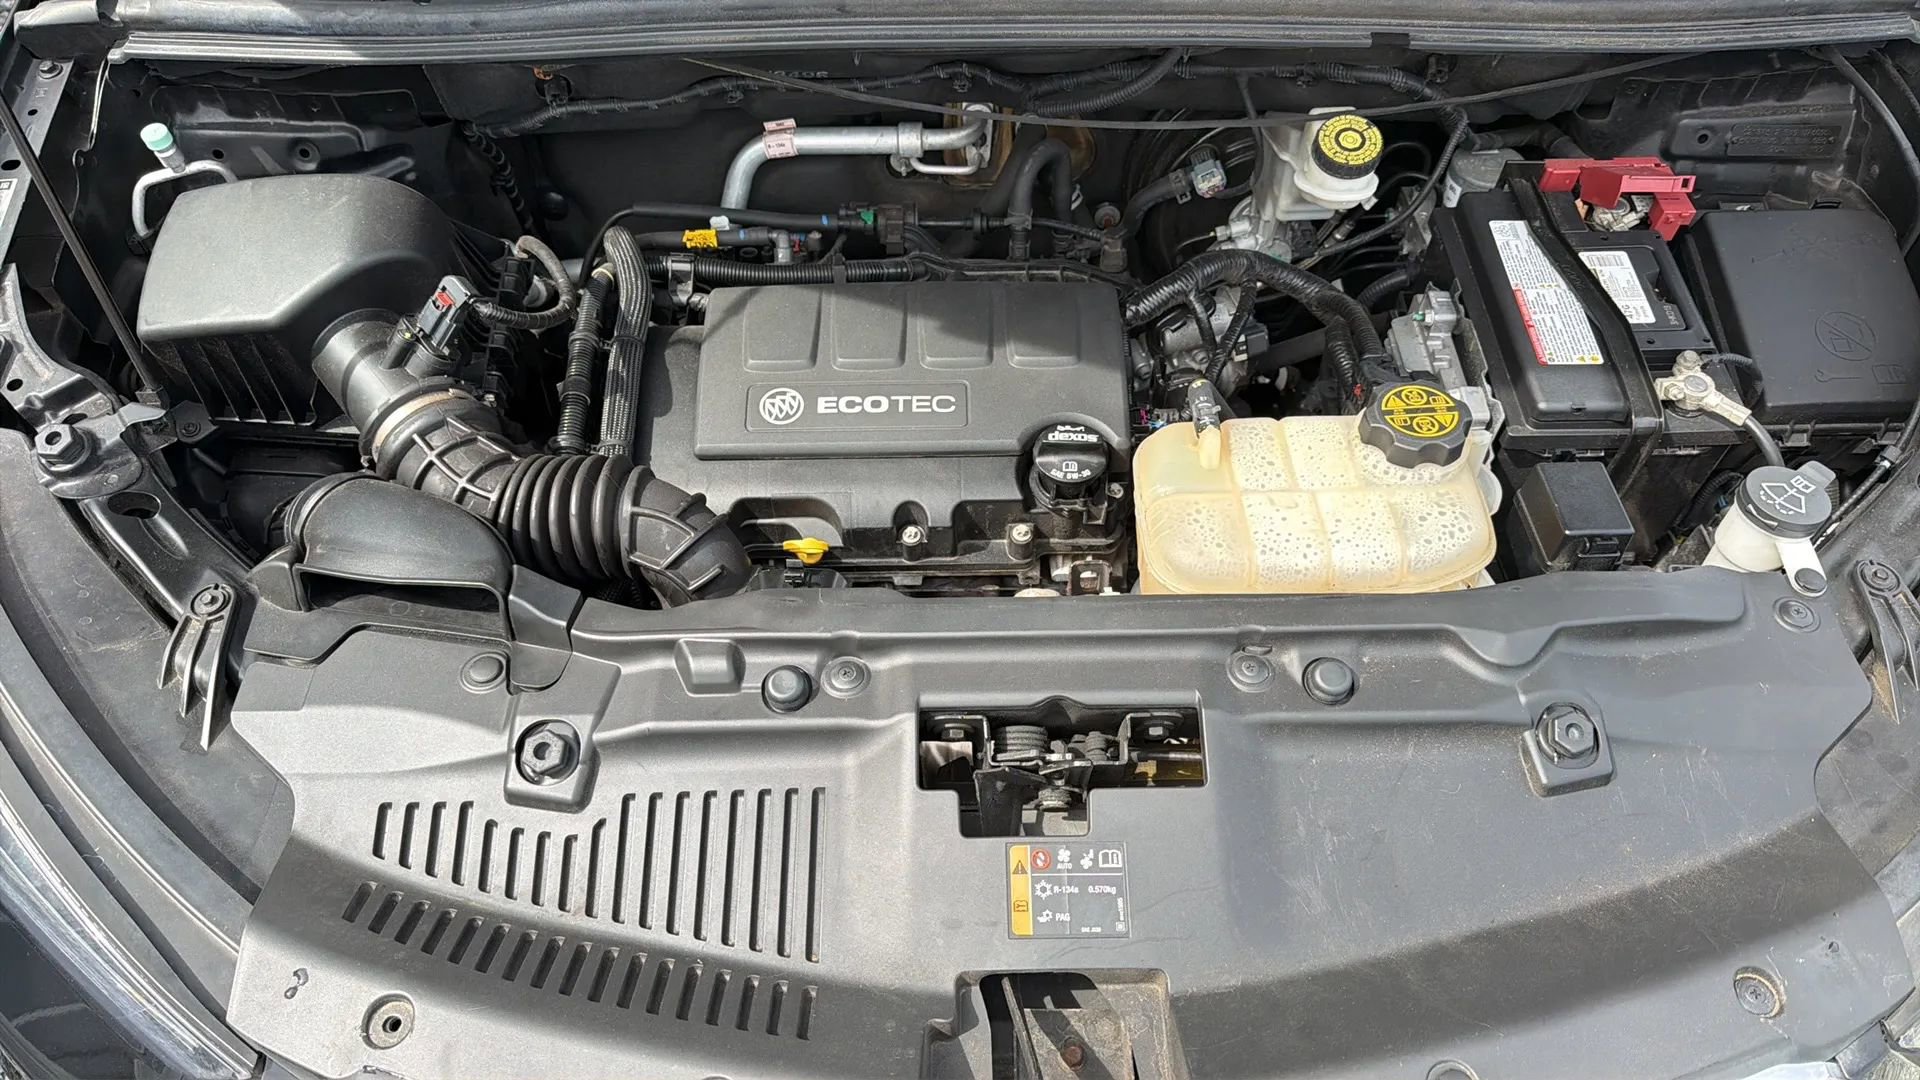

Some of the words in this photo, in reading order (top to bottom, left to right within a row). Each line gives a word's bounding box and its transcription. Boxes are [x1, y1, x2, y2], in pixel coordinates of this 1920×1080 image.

[817, 395, 956, 413] ECOTEC
[1047, 430, 1099, 442] dexos
[1088, 886, 1117, 894] 0.570kg
[1055, 913, 1070, 921] PAG
